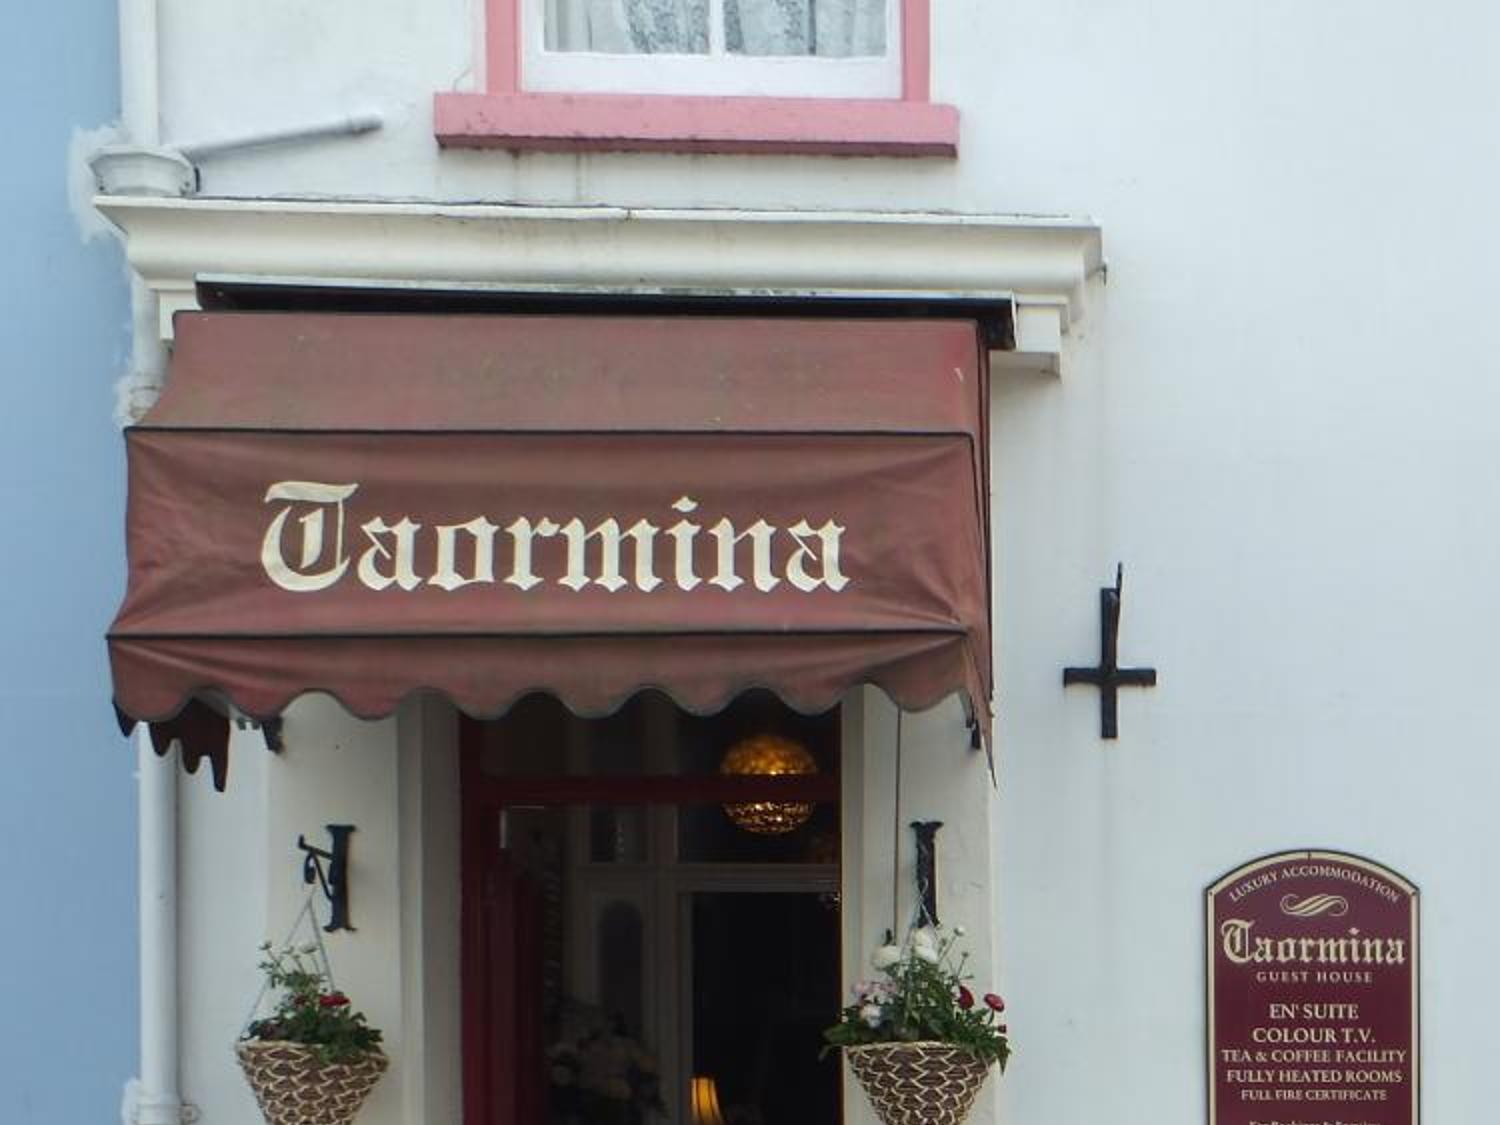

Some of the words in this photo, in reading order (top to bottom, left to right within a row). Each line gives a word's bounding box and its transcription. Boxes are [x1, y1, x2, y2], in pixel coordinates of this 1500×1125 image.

[261, 480, 850, 593] Taormina
[1229, 871, 1277, 902] LUXURY
[1221, 918, 1405, 964] Taormina
[1256, 971, 1309, 983] GUEST
[1317, 971, 1373, 983] HOUSE
[1303, 1003, 1359, 1019] SUITE
[1252, 1027, 1337, 1043] COLOUR
[1341, 1027, 1377, 1043] T.V.
[1222, 1050, 1251, 1063] TEA
[1255, 1051, 1268, 1063] &
[1271, 1050, 1332, 1063] COFFEE
[1335, 1050, 1406, 1064] FACILITY
[1227, 1069, 1275, 1083] FULLY
[1279, 1069, 1342, 1083] HEATED
[1345, 1069, 1402, 1083] ROOMS
[1241, 1089, 1272, 1101] FULL
[1275, 1089, 1302, 1101] FIRE
[1305, 1089, 1388, 1101] CERTIFICATE
